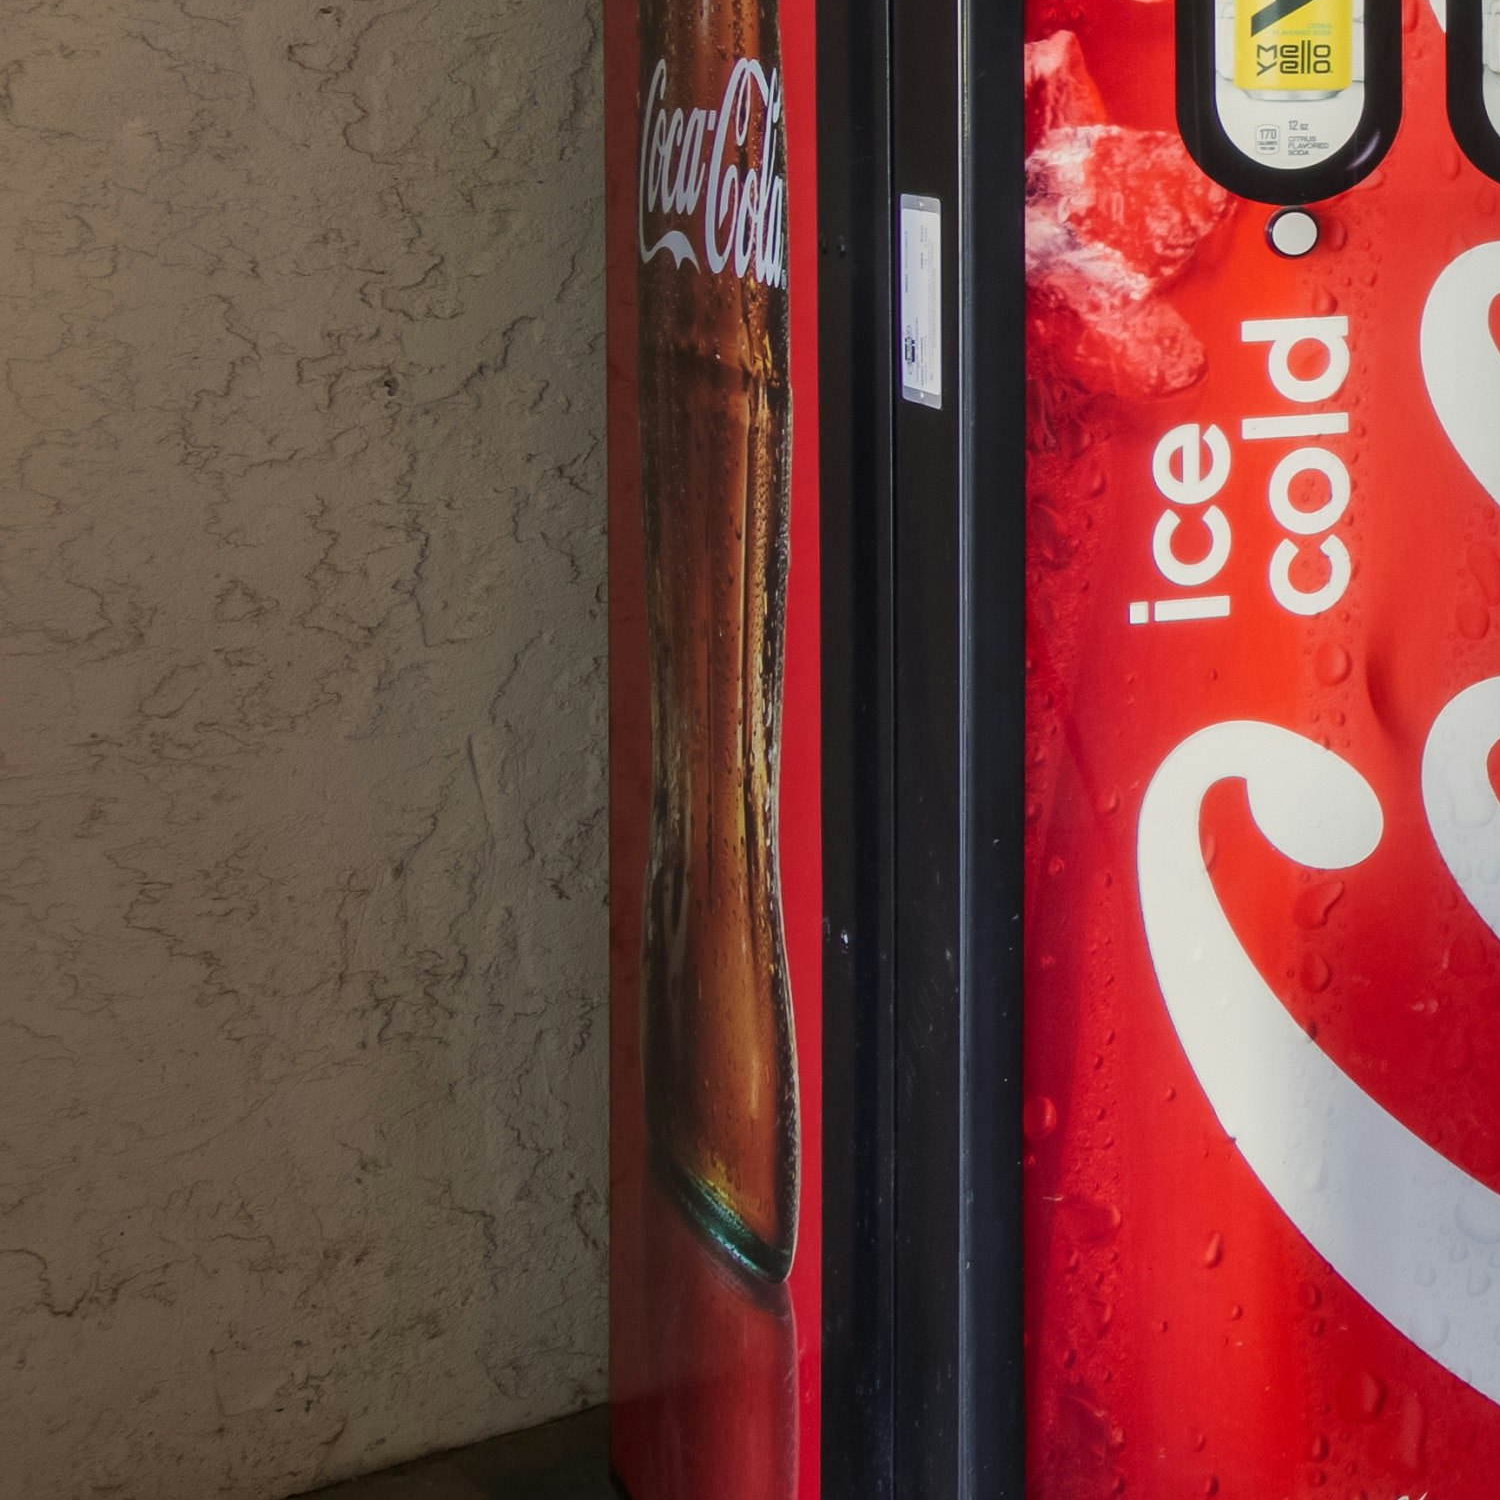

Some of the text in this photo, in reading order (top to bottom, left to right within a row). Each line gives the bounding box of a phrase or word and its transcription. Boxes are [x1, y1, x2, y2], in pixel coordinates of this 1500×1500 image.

[1288, 119, 1298, 131] 12
[1259, 128, 1277, 140] 170
[1287, 135, 1317, 143] CITRUS
[1287, 142, 1330, 150] FLAVORED
[638, 58, 786, 289] Coca-Cola
[1240, 315, 1352, 616] cold
[1129, 422, 1232, 625] ice
